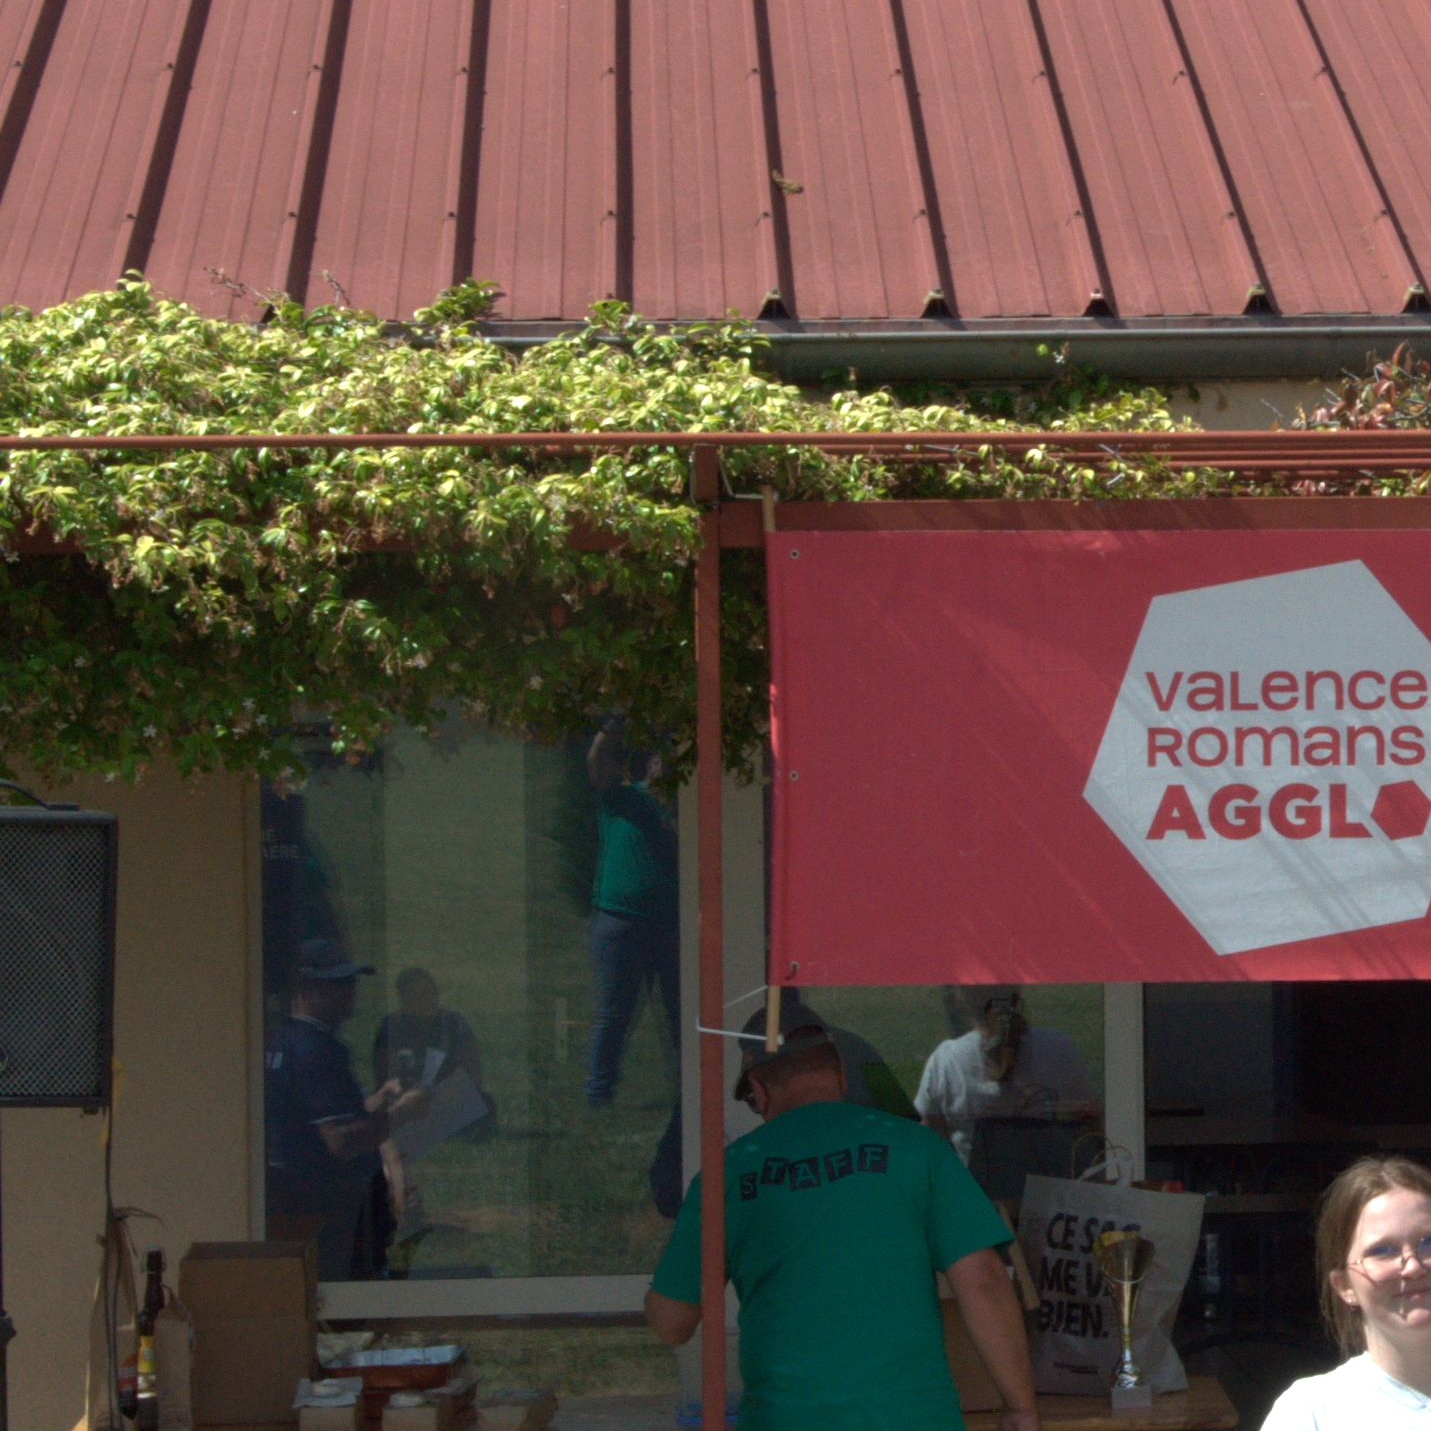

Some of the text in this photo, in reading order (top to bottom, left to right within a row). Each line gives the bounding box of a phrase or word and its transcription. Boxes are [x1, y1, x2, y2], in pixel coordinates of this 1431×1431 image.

[739, 1143, 889, 1201] STAFF
[1046, 1212, 1078, 1252] CE
[1038, 1255, 1078, 1295] ME
